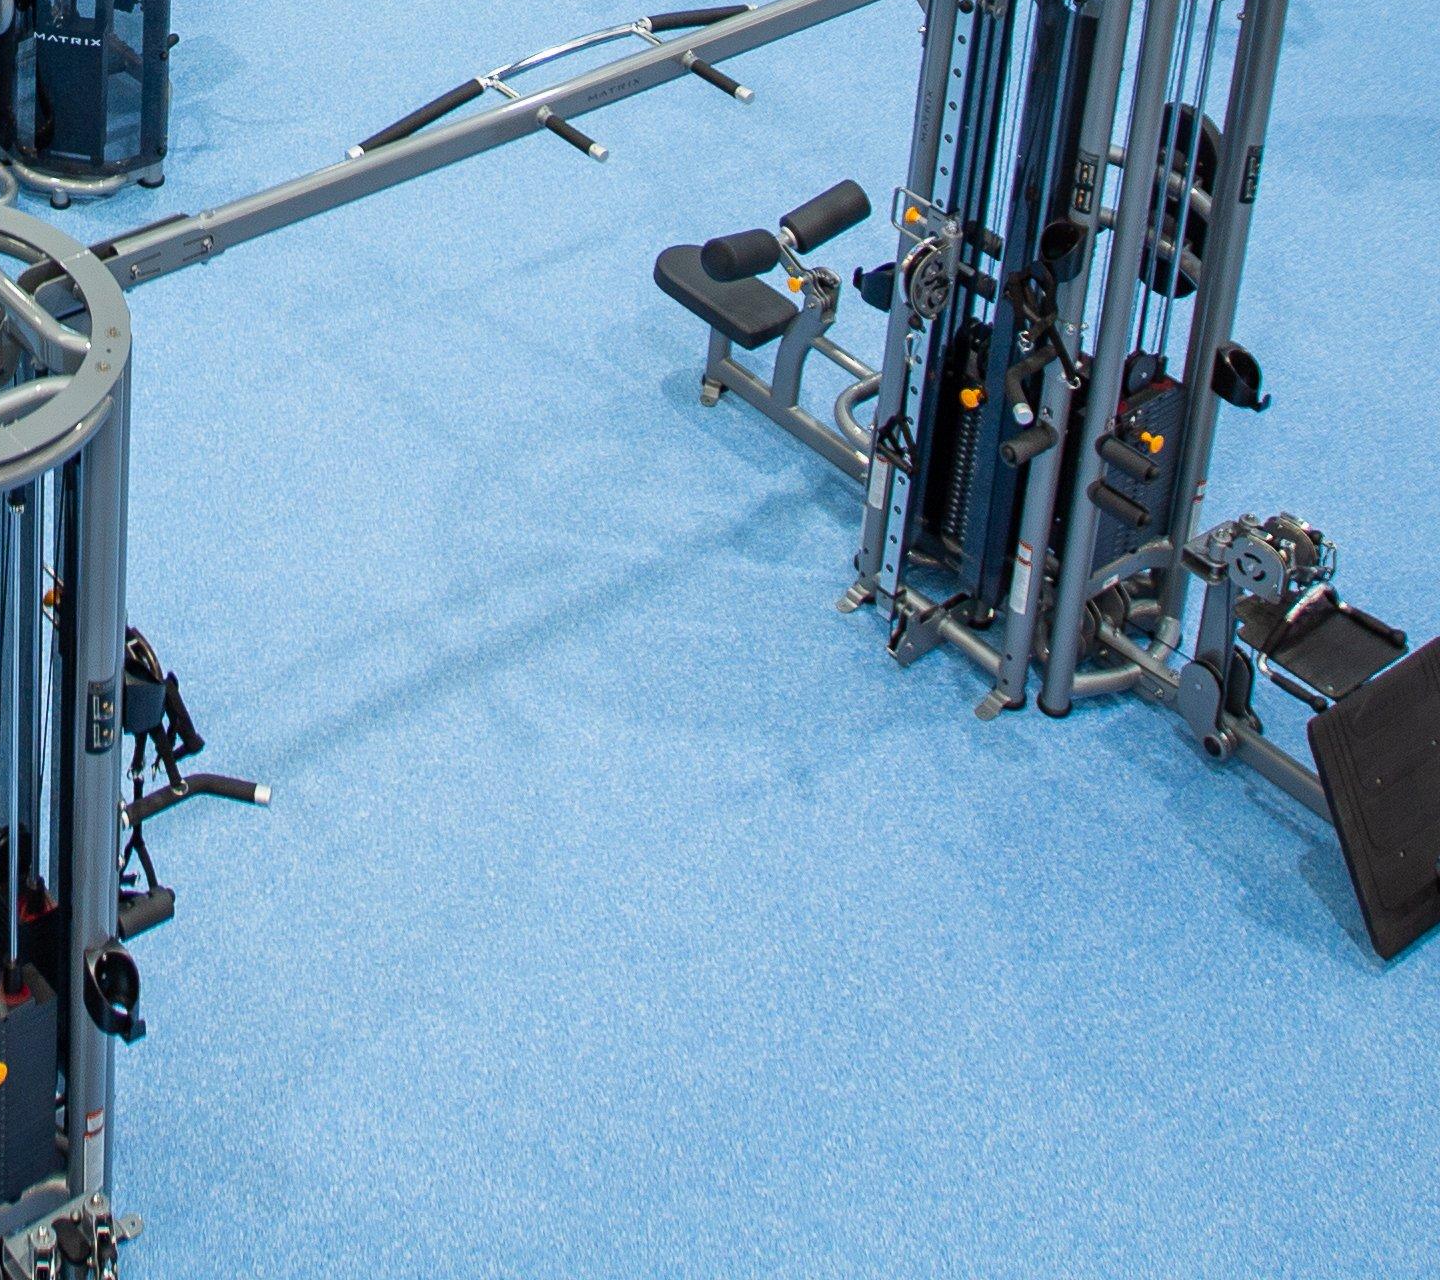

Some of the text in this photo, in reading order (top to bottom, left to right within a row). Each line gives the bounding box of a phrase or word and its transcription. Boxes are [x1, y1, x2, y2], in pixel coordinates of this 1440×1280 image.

[33, 31, 101, 47] MATRIX
[587, 77, 640, 102] MATRIX
[920, 90, 933, 142] MATRIX
